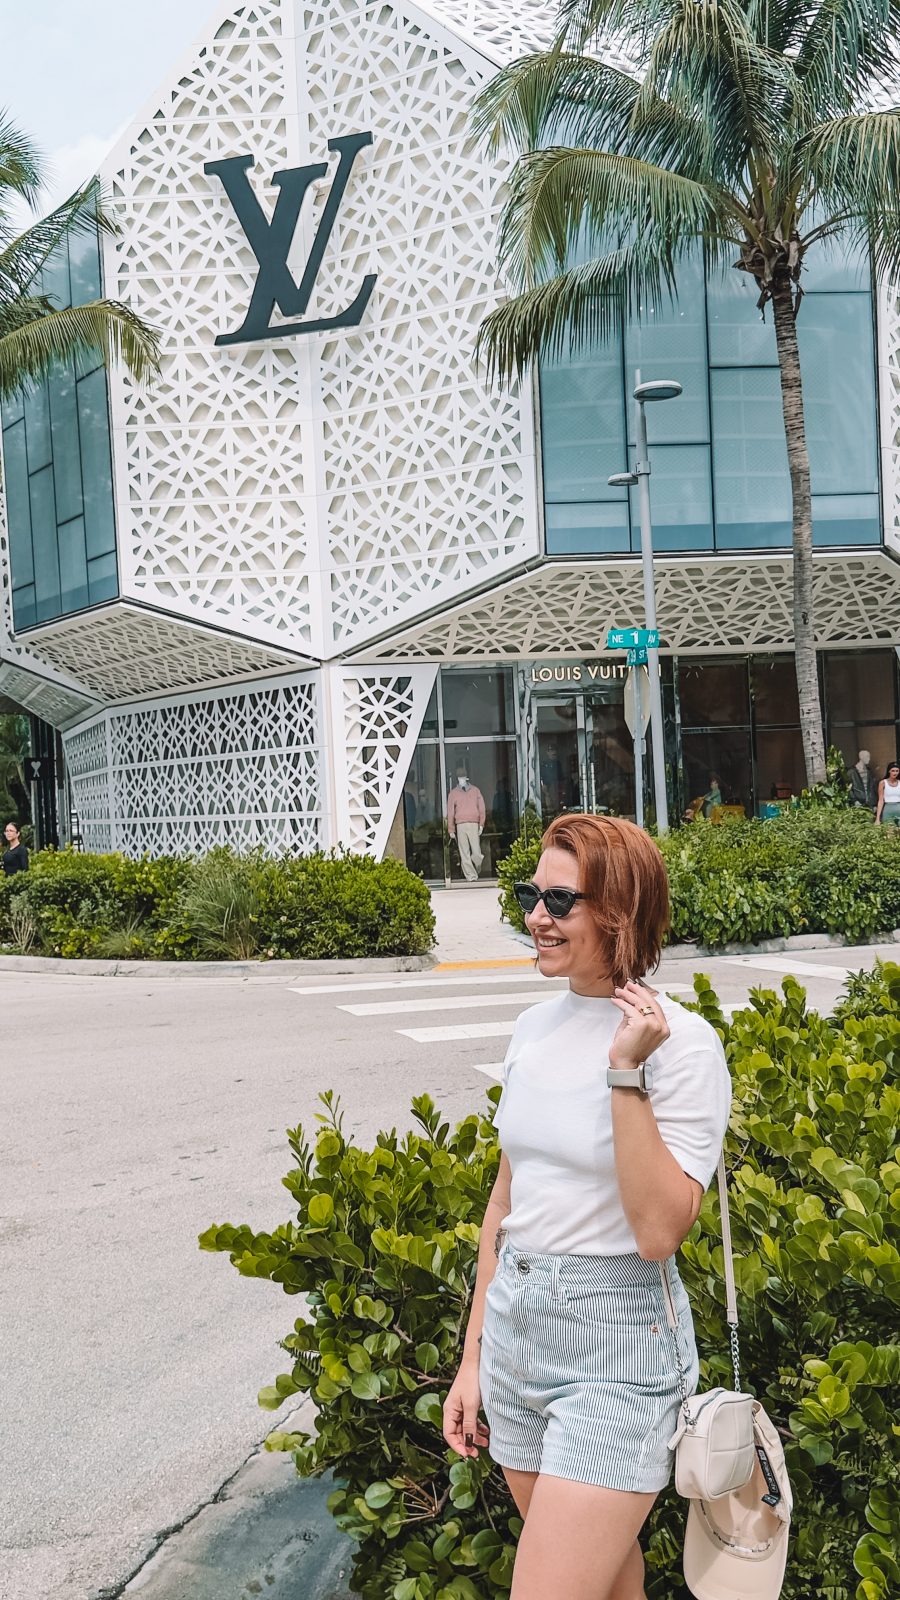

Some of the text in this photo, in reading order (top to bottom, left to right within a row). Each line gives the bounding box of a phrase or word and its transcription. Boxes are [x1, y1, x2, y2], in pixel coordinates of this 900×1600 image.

[204, 131, 378, 346] LV
[611, 630, 656, 645] NE 1 AV
[638, 649, 645, 659] ST
[531, 663, 662, 682] LOUIS VUIT
